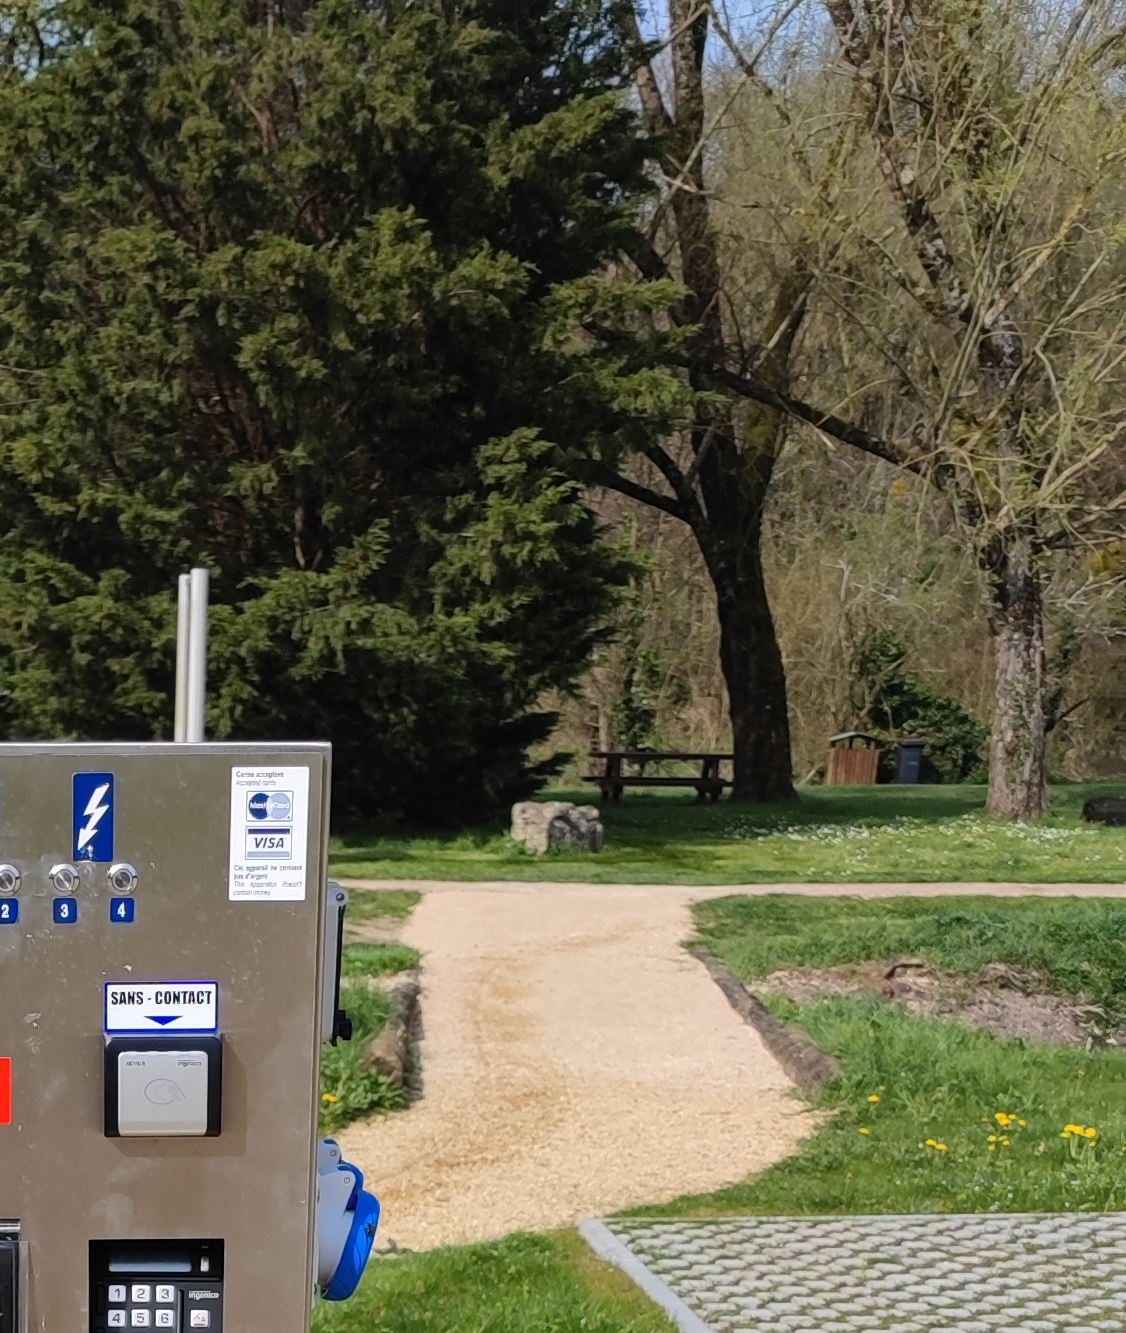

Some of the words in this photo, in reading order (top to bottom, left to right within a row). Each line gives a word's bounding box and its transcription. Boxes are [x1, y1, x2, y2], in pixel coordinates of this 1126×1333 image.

[254, 837, 285, 849] VISA
[1, 904, 10, 918] 2
[60, 904, 69, 918] 3
[117, 902, 126, 917] 4
[111, 991, 144, 1005] SANS
[155, 990, 212, 1005] CONTACT
[114, 1288, 121, 1299] 1
[136, 1288, 145, 1299] 2
[161, 1288, 170, 1299] 3
[112, 1313, 121, 1323] 4
[136, 1313, 145, 1323] 5
[160, 1313, 169, 1323] 6
